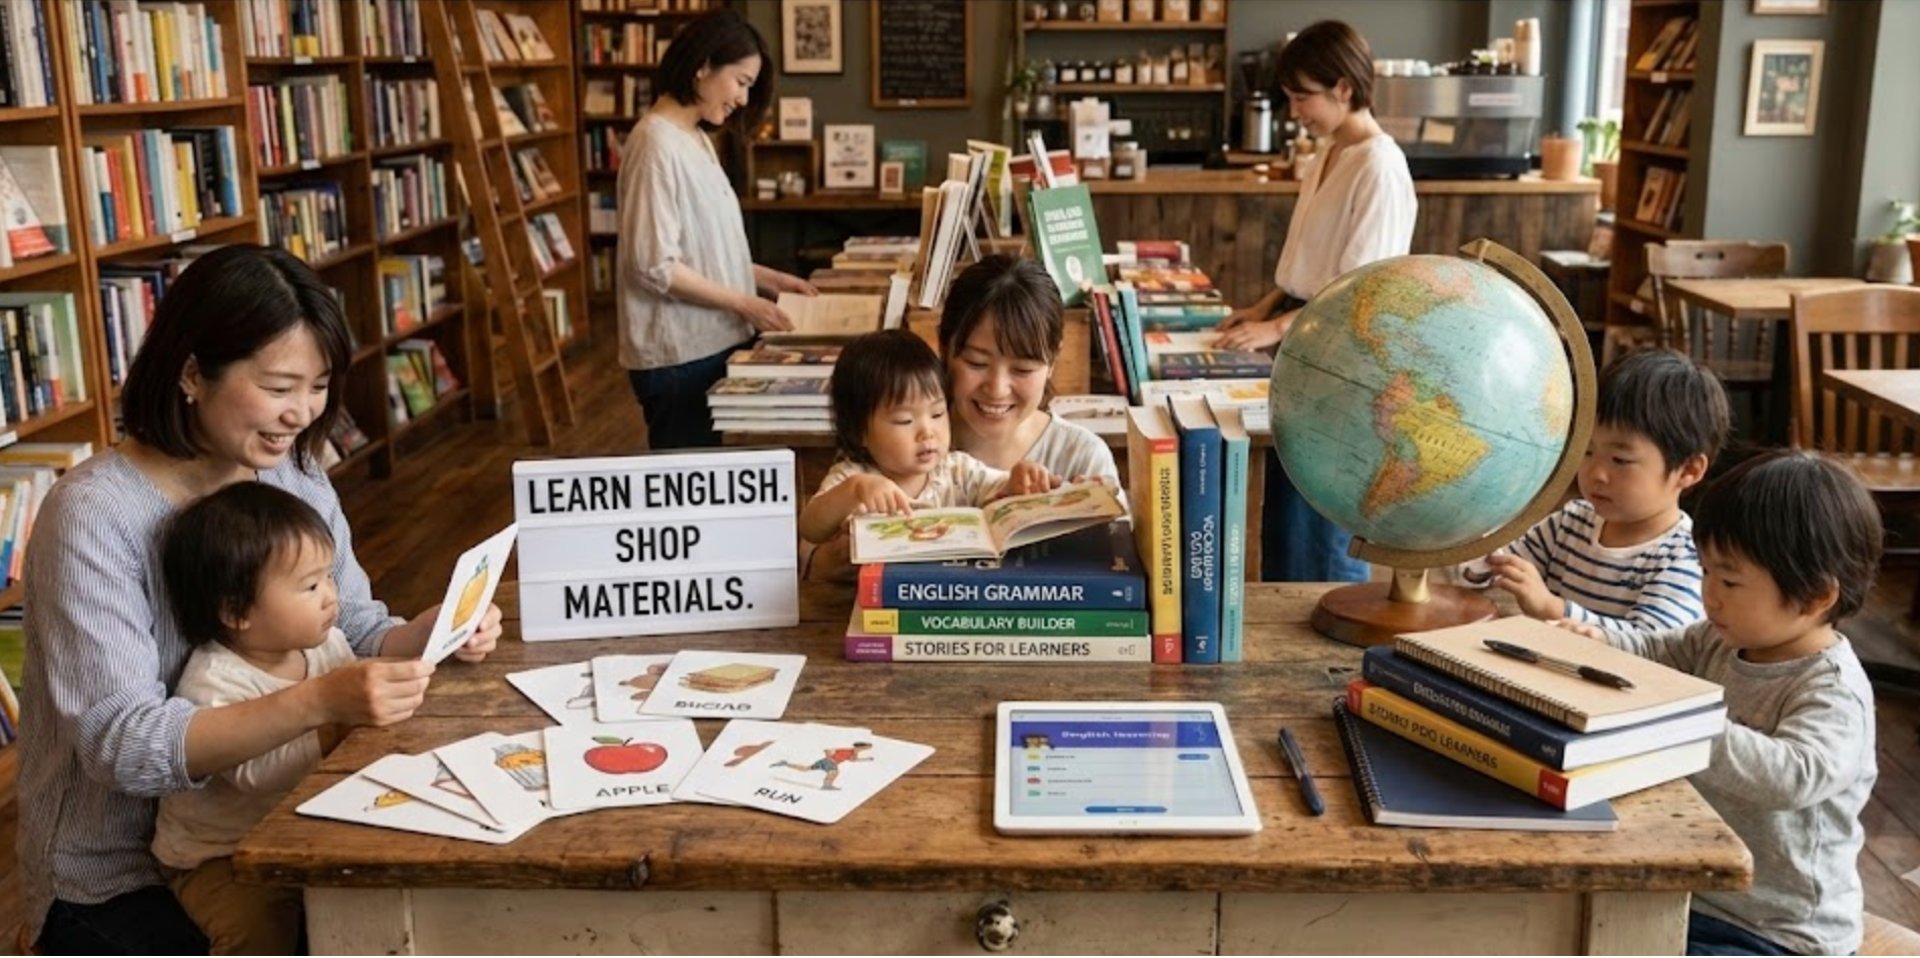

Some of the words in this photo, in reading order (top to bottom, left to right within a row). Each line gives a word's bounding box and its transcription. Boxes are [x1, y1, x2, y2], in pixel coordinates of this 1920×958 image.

[528, 475, 631, 514] LEARN
[644, 468, 788, 508] ENGLISH.
[616, 525, 700, 562] SHOP
[564, 576, 753, 619] MATERIALS.
[897, 584, 978, 601] ENGLISH
[984, 584, 1084, 601] GRAMMAR
[921, 616, 1014, 630] VOCABULARY
[1017, 616, 1076, 630] BUILDER
[904, 642, 970, 656] STORIES
[973, 642, 1006, 656] FOR
[1009, 642, 1091, 656] LEARNERS
[596, 784, 670, 797] APPLE
[754, 787, 801, 804] RUN
